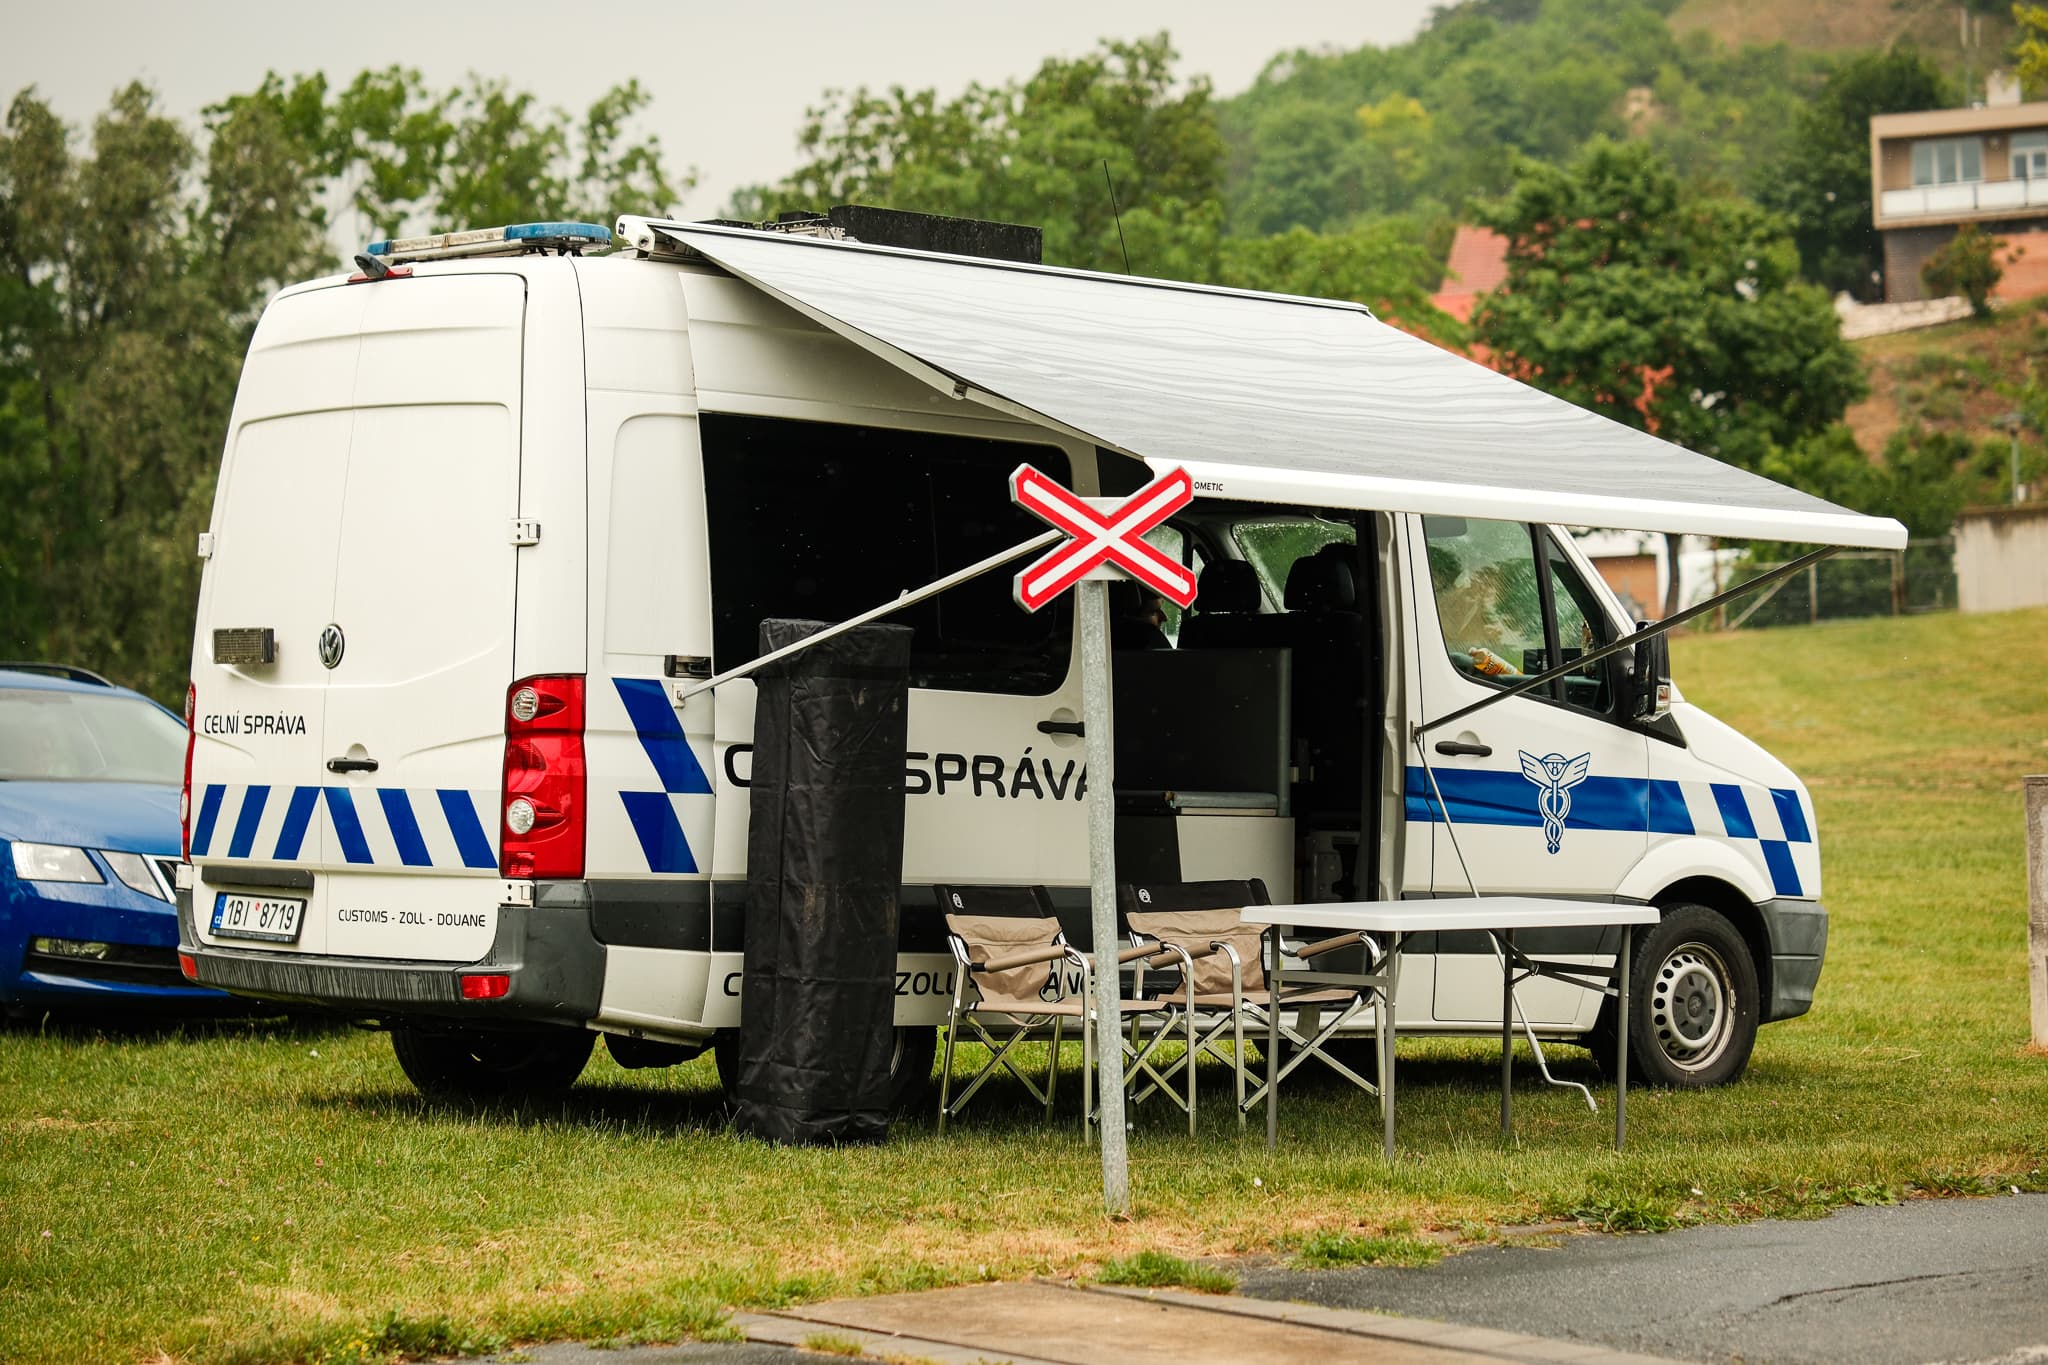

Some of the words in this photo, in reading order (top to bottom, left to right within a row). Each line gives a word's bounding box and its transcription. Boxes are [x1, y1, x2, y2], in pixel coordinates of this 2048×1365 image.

[1194, 481, 1223, 492] OMETIC
[204, 710, 240, 734] CELNÍ
[243, 710, 306, 735] SPRÁVA
[228, 900, 250, 927] 1BI
[260, 902, 295, 930] 8719
[338, 909, 388, 923] CUSTOMS
[399, 911, 426, 925] ZOLL
[437, 913, 486, 928] DOUANE
